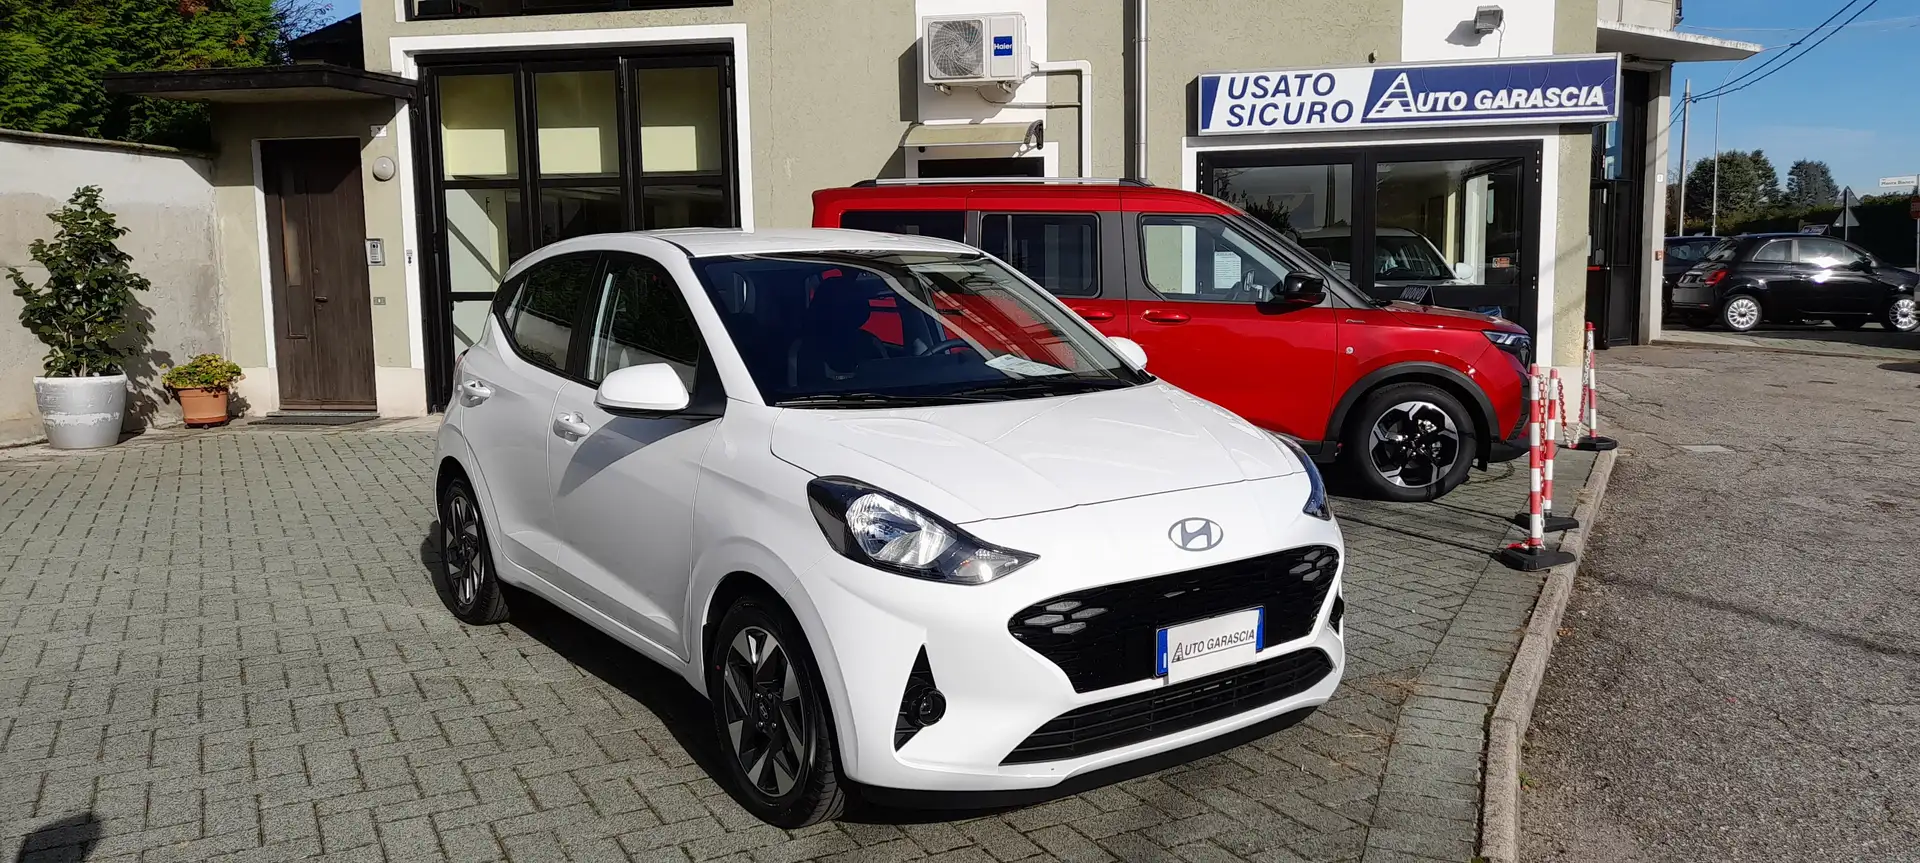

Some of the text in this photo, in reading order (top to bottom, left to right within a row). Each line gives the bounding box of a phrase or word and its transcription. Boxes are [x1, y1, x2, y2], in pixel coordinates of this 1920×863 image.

[1228, 73, 1336, 100] USATO
[1367, 72, 1604, 118] AUTO GARASCIA
[1226, 100, 1354, 127] SICURO
[1400, 286, 1426, 300] NUOVO
[1171, 629, 1255, 663] AUTO GARASCIA
